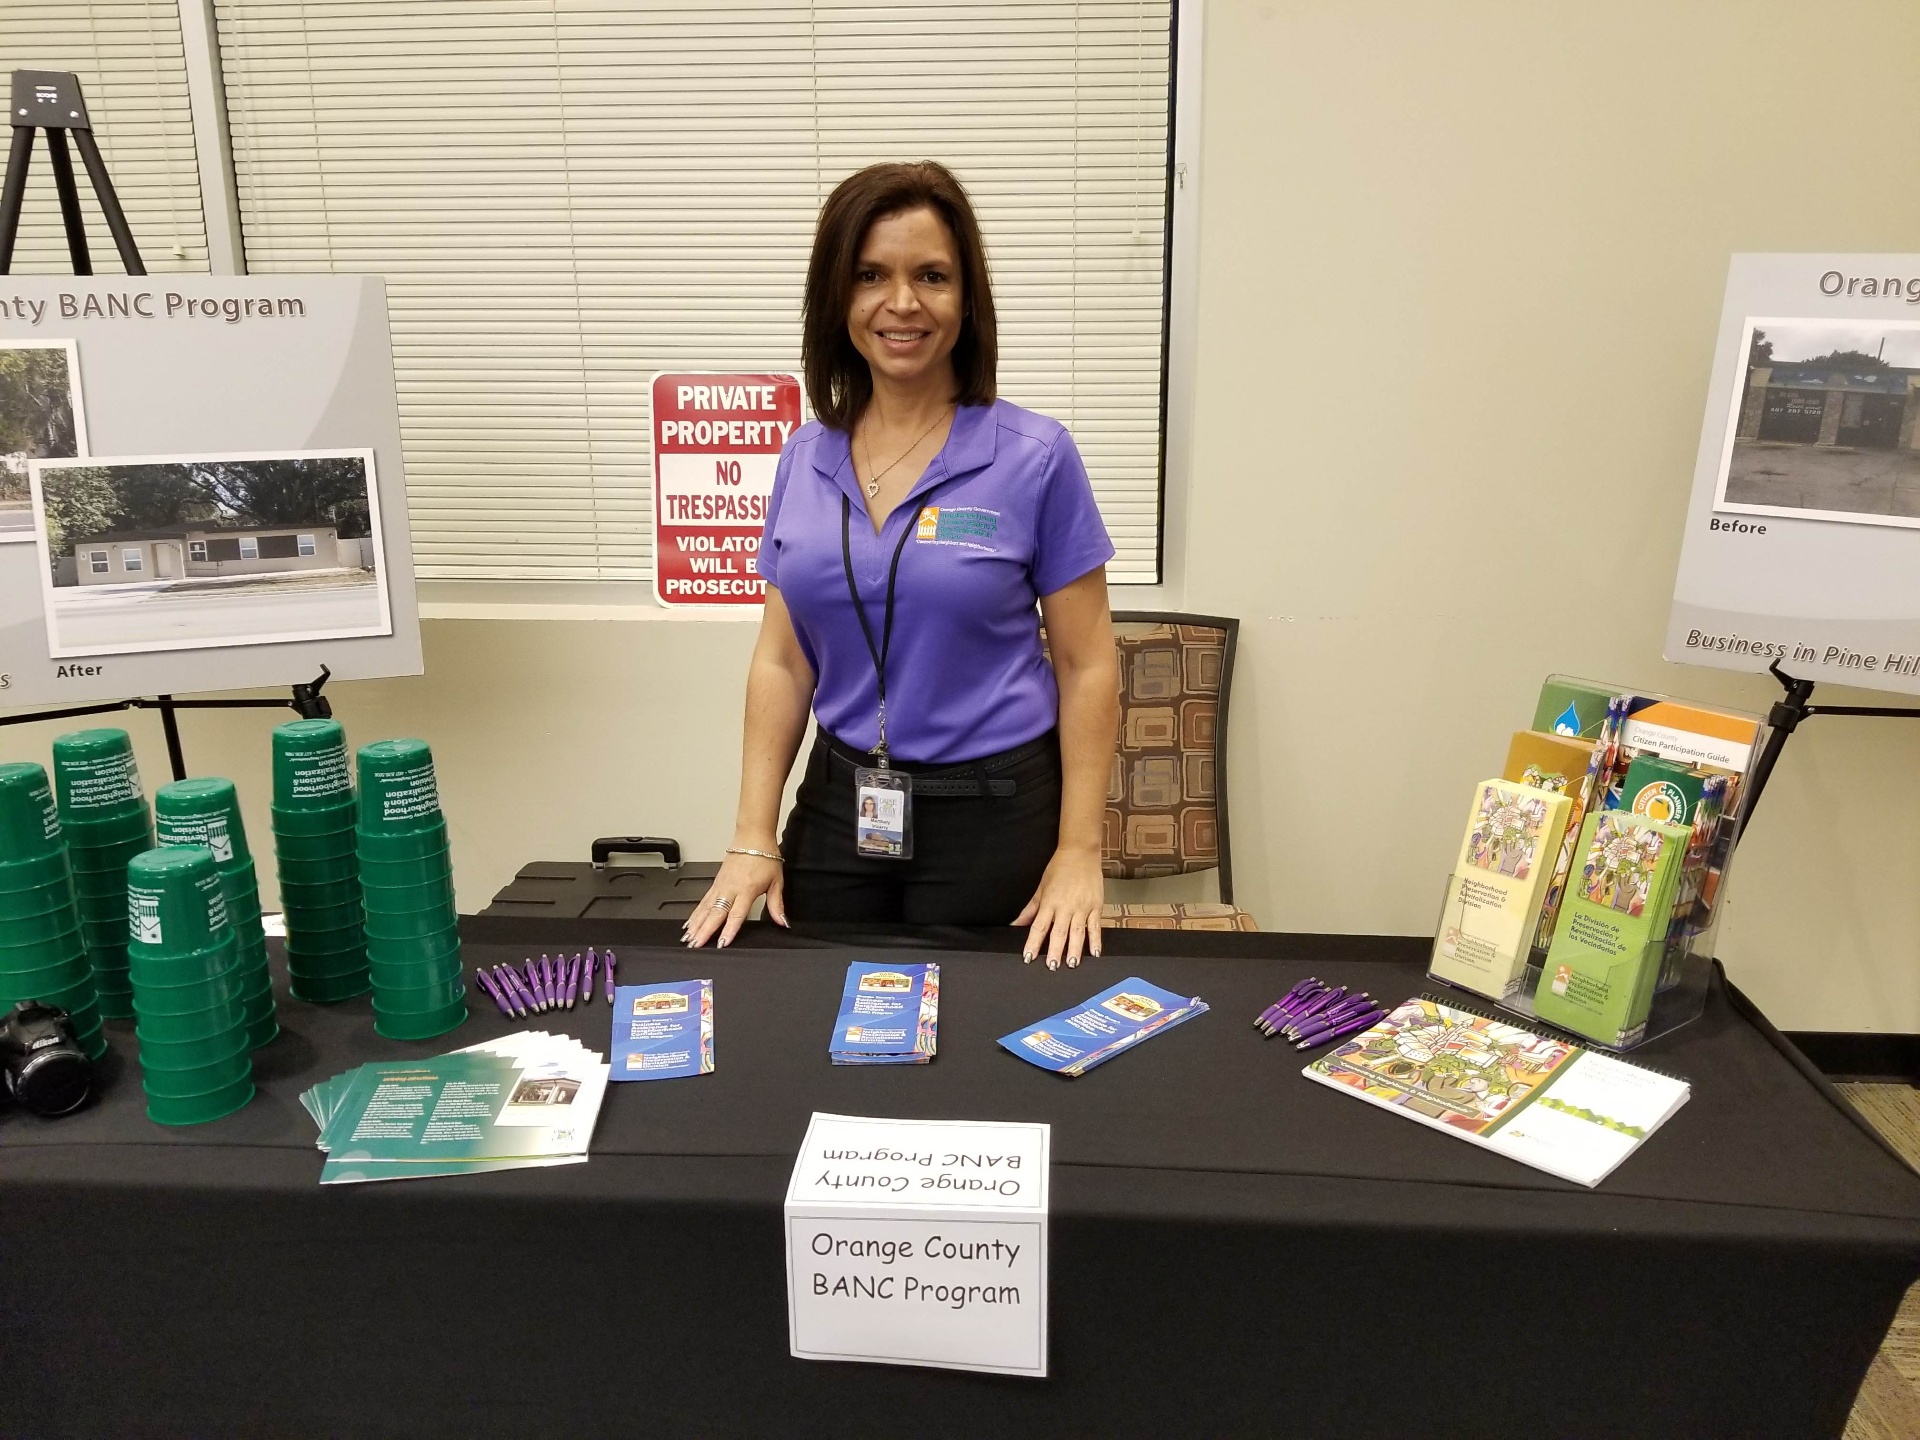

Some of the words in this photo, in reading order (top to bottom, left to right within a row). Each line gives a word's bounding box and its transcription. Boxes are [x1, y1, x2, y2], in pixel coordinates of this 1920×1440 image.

[1818, 270, 1920, 304] Orang
[59, 293, 153, 318] BANC
[166, 292, 305, 322] Program
[678, 385, 776, 410] PRIVATE
[661, 420, 793, 445] PROPERTY
[716, 461, 741, 486] NO
[666, 494, 771, 520] TRESPASSI
[1710, 518, 1767, 536] Before
[689, 558, 737, 574] WILL
[745, 558, 758, 574] B
[666, 579, 767, 595] PROSECUT
[1686, 629, 1787, 658] Business
[1792, 642, 1816, 661] in
[1823, 646, 1877, 669] Pine
[57, 664, 102, 678] After
[1634, 727, 1656, 737] Orange
[1657, 731, 1678, 742] County
[1632, 735, 1657, 747] Citizen
[1659, 741, 1705, 758] Participation
[1707, 752, 1730, 763] Guide
[318, 755, 345, 767] Division
[95, 765, 126, 776] Division
[295, 763, 346, 777] Revitalization
[300, 770, 347, 784] Preservation
[71, 772, 127, 787] Revitalization
[76, 780, 130, 795] Preservation
[293, 779, 348, 794] Neighborhood
[410, 776, 434, 787] Division
[70, 787, 131, 803] Neighborhood
[385, 783, 435, 798] Revitalization
[384, 800, 390, 808] &
[384, 799, 438, 815] Neighborhood
[390, 791, 437, 807] Preservation
[1638, 788, 1657, 810] CITIZEN
[1667, 789, 1682, 820] PLANNER
[172, 825, 207, 834] Division
[1462, 884, 1499, 901] Preservation
[1464, 877, 1508, 896] Neighborhood
[1458, 897, 1481, 909] Division
[1460, 891, 1502, 908] Revitalization
[1574, 912, 1582, 920] La
[1583, 915, 1609, 929] División
[1611, 925, 1620, 933] de
[1568, 932, 1578, 941] los
[1580, 936, 1617, 955] Vecindarios
[1617, 943, 1627, 952] de
[823, 1148, 933, 1167] Program
[941, 1155, 1021, 1169] BANC
[815, 1170, 909, 1193] County
[921, 1173, 1020, 1196] Orange
[811, 1233, 914, 1264] Orange
[924, 1236, 1021, 1268] County
[813, 1273, 894, 1299] BANC
[904, 1277, 1021, 1309] Program
